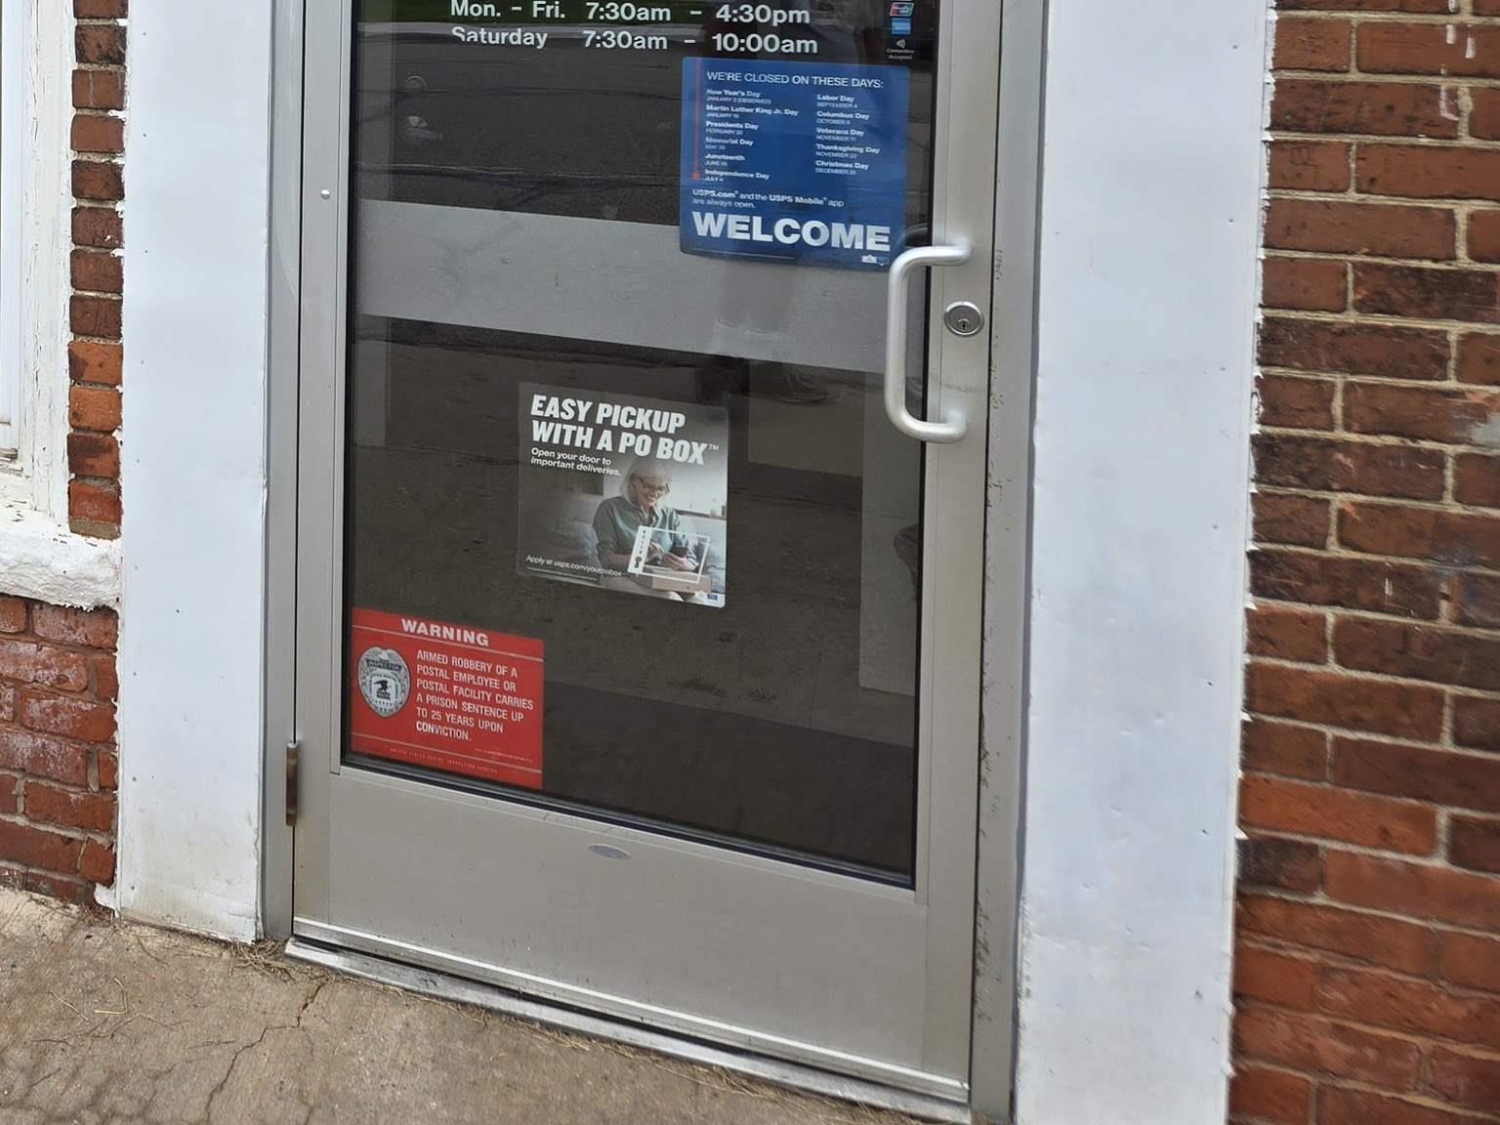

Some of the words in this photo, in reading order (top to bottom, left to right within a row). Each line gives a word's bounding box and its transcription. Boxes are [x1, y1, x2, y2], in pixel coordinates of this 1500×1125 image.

[451, 0, 501, 17] Mon.
[532, 0, 565, 19] Fri.
[586, 3, 671, 21] 7:30am
[716, 4, 810, 26] 4:30pm
[451, 26, 548, 49] Saturday
[583, 30, 668, 50] 7:30am
[712, 33, 818, 54] 10:00am
[707, 71, 742, 82] WE'RE
[745, 73, 789, 84] CLOSED
[792, 75, 810, 85] ON
[812, 76, 848, 87] THESE
[851, 78, 884, 88] DAYS:
[756, 107, 772, 115] King
[706, 121, 743, 129] Presidents
[745, 122, 759, 130] Day
[816, 127, 848, 135] Veterans
[850, 129, 864, 137] Day
[816, 144, 863, 153] Thanksgiving
[705, 169, 754, 178] Independence
[756, 172, 770, 180] Day
[815, 160, 853, 168] Christmas
[854, 162, 869, 170] Day
[706, 198, 731, 207] always
[755, 193, 767, 201] the
[769, 194, 792, 202] USPS
[828, 199, 844, 208] app
[692, 211, 891, 252] WELCOME
[530, 395, 593, 422] EASY
[595, 403, 685, 434] PICKUP
[532, 420, 592, 449] WITH
[596, 430, 612, 451] A
[619, 432, 652, 456] PO
[531, 447, 555, 458] Open
[557, 452, 577, 462] your
[579, 453, 600, 464] door
[602, 457, 611, 465] to
[531, 457, 575, 470] important
[576, 462, 621, 476] deliveries.
[526, 554, 545, 568] Apply
[402, 618, 489, 647] WARNING
[417, 650, 448, 664] ARMED
[452, 656, 492, 673] ROBBERY
[496, 665, 508, 675] OF
[510, 668, 518, 678] A
[417, 664, 449, 679] POSTAL
[453, 672, 500, 690] EMPLOYEE
[503, 681, 516, 692] OR
[417, 679, 449, 694] POSTAL
[453, 686, 492, 702] FACILITY
[495, 694, 534, 711] CARRIES
[416, 693, 423, 703] A
[426, 695, 458, 710] PRISON
[461, 703, 507, 720] SENTENCE
[511, 712, 524, 722] UP
[416, 707, 428, 718] TO
[431, 710, 442, 721] 25
[445, 714, 475, 728] YEARS
[478, 719, 503, 733] UPON
[416, 721, 472, 742] CONVICTION.
